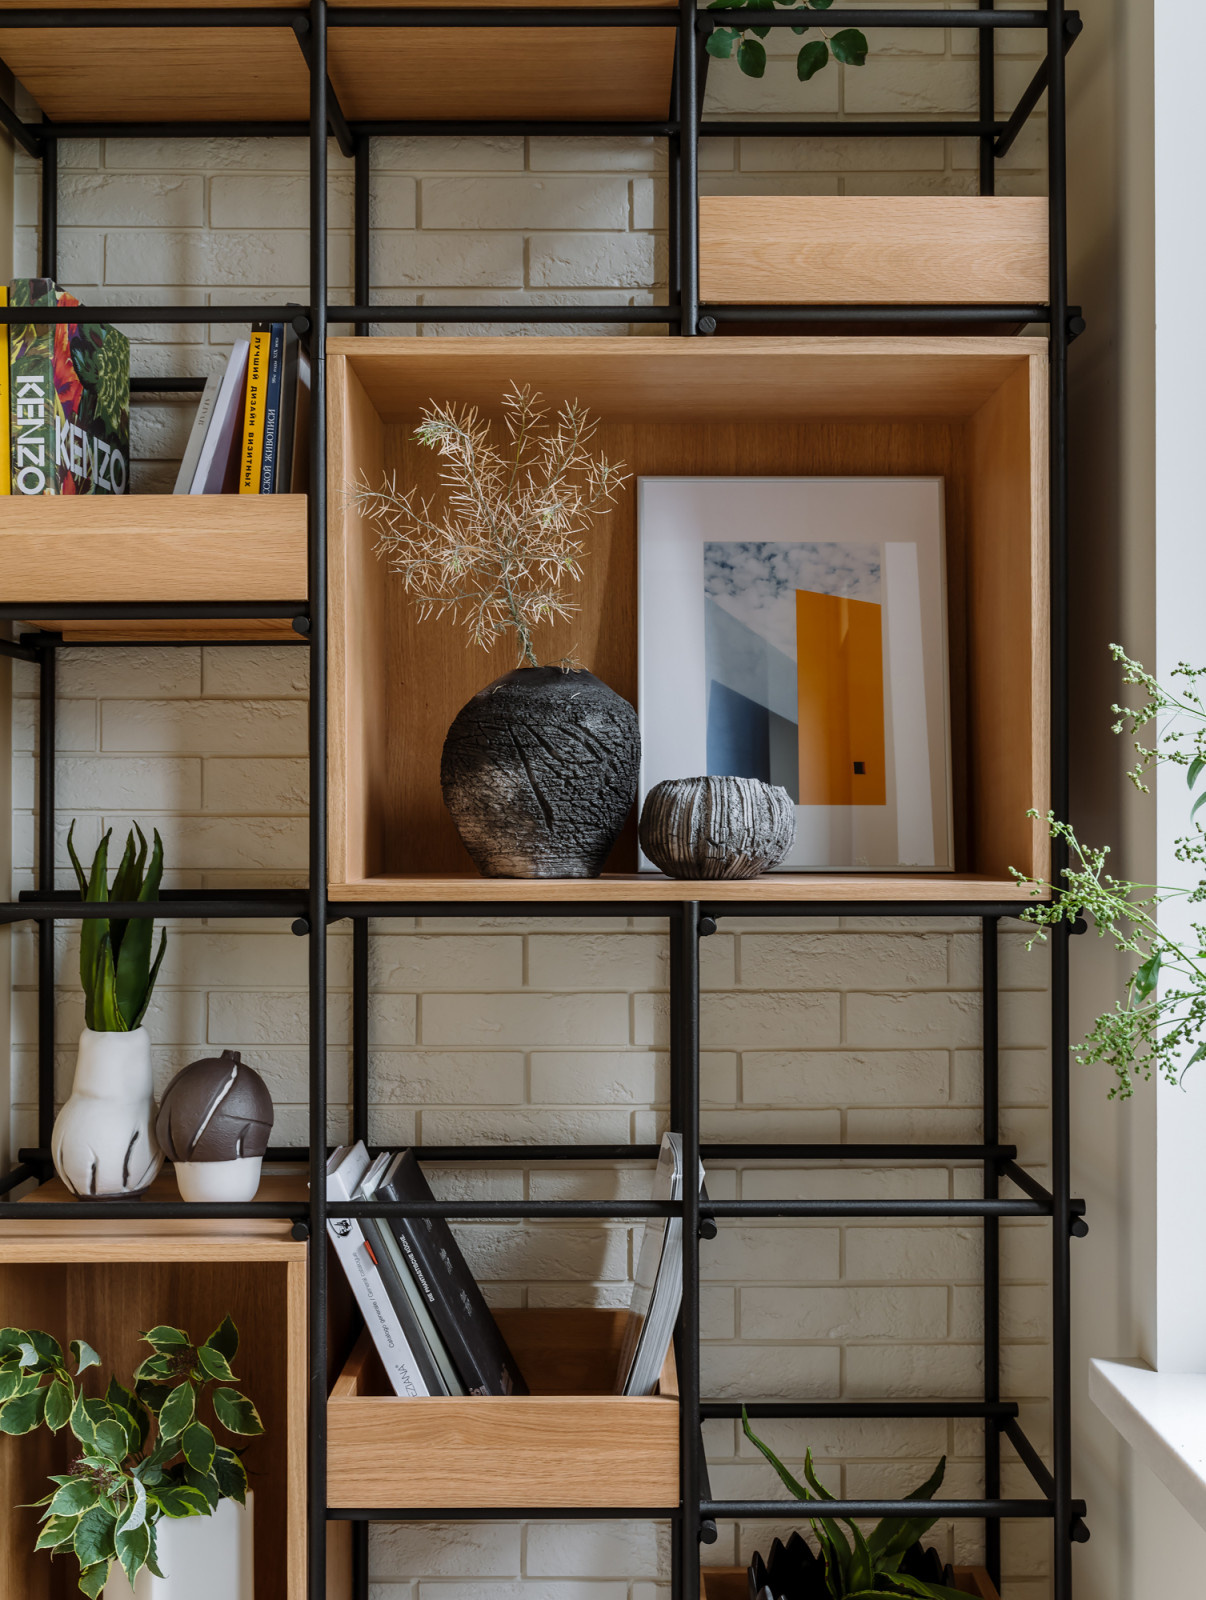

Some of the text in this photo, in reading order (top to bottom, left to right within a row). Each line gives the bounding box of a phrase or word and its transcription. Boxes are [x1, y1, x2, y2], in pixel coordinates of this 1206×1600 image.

[244, 336, 261, 487] ЛУЧШИЙ ДИЗАЙН ВИЗИТНЫХ
[17, 375, 45, 495] KENZO
[264, 409, 276, 462] ЖИВОПИСИ
[55, 415, 126, 495] KENZO
[352, 1251, 366, 1277] catalogue
[362, 1277, 374, 1298] General
[426, 1292, 435, 1303] DIE
[372, 1301, 386, 1324] generale
[382, 1324, 395, 1348] Catalogo
